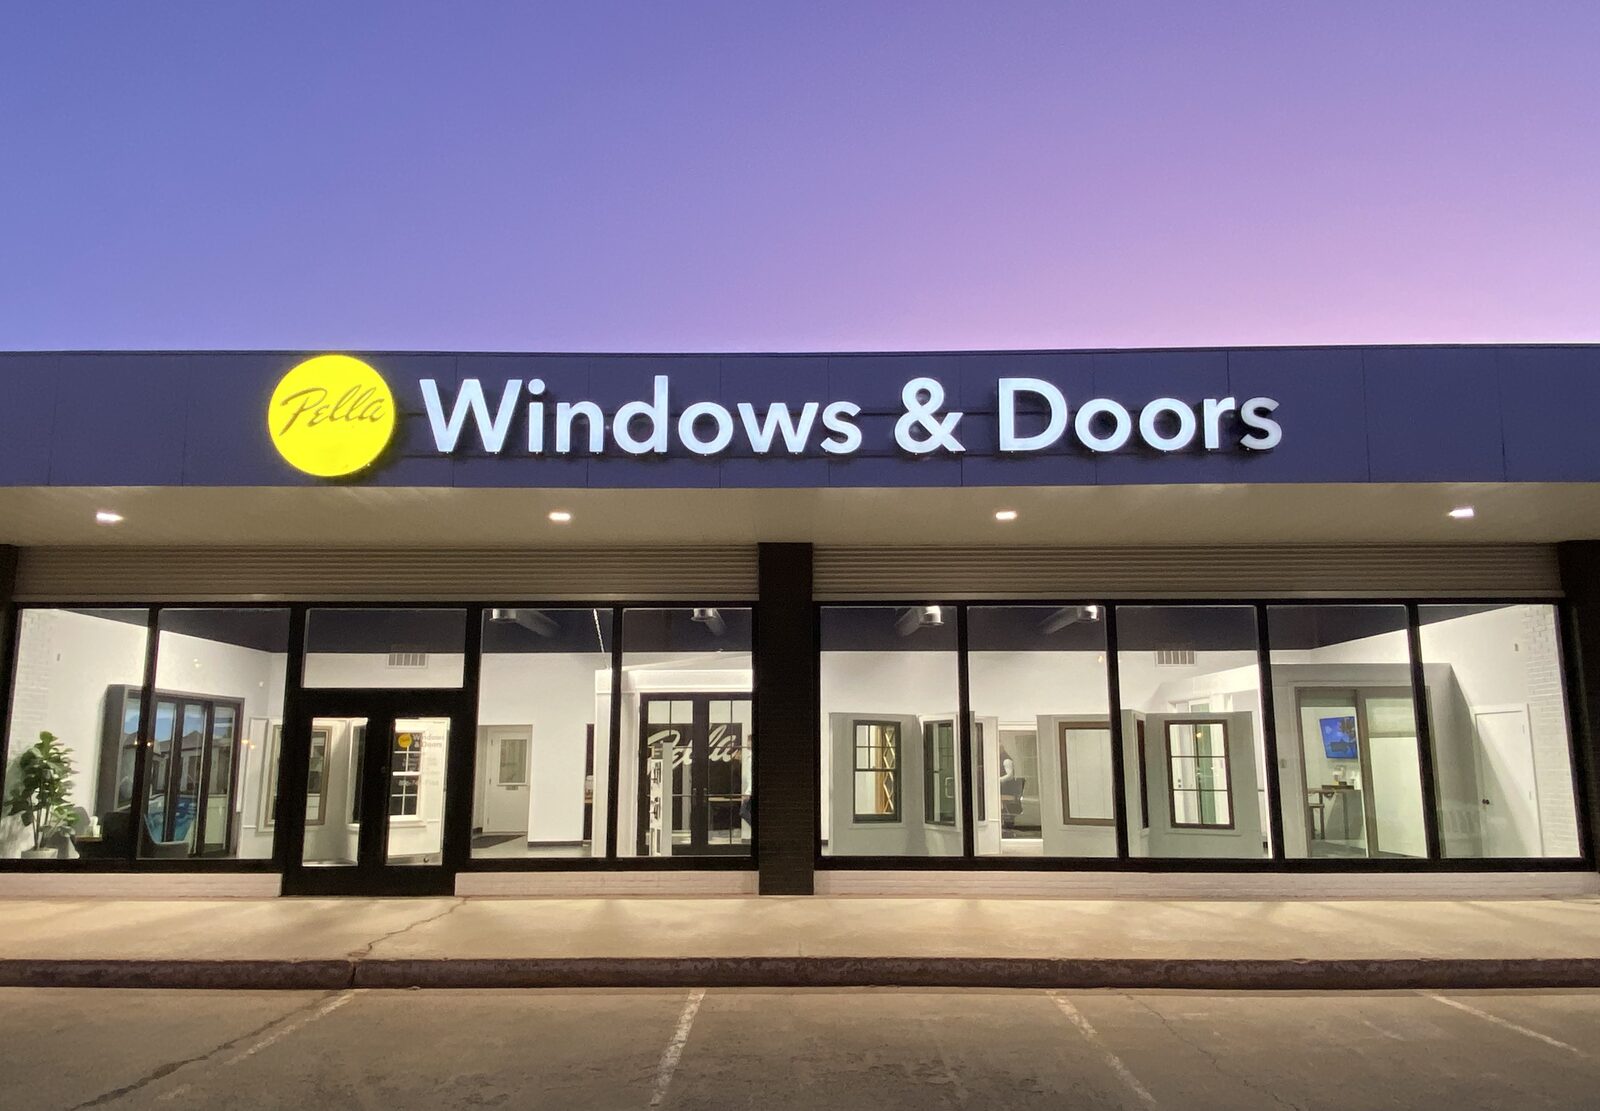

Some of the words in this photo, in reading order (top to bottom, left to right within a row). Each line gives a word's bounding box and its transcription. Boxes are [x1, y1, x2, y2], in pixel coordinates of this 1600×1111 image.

[279, 384, 386, 437] Pella
[419, 375, 862, 455] Windows
[894, 376, 966, 455] &
[998, 377, 1283, 454] Doors
